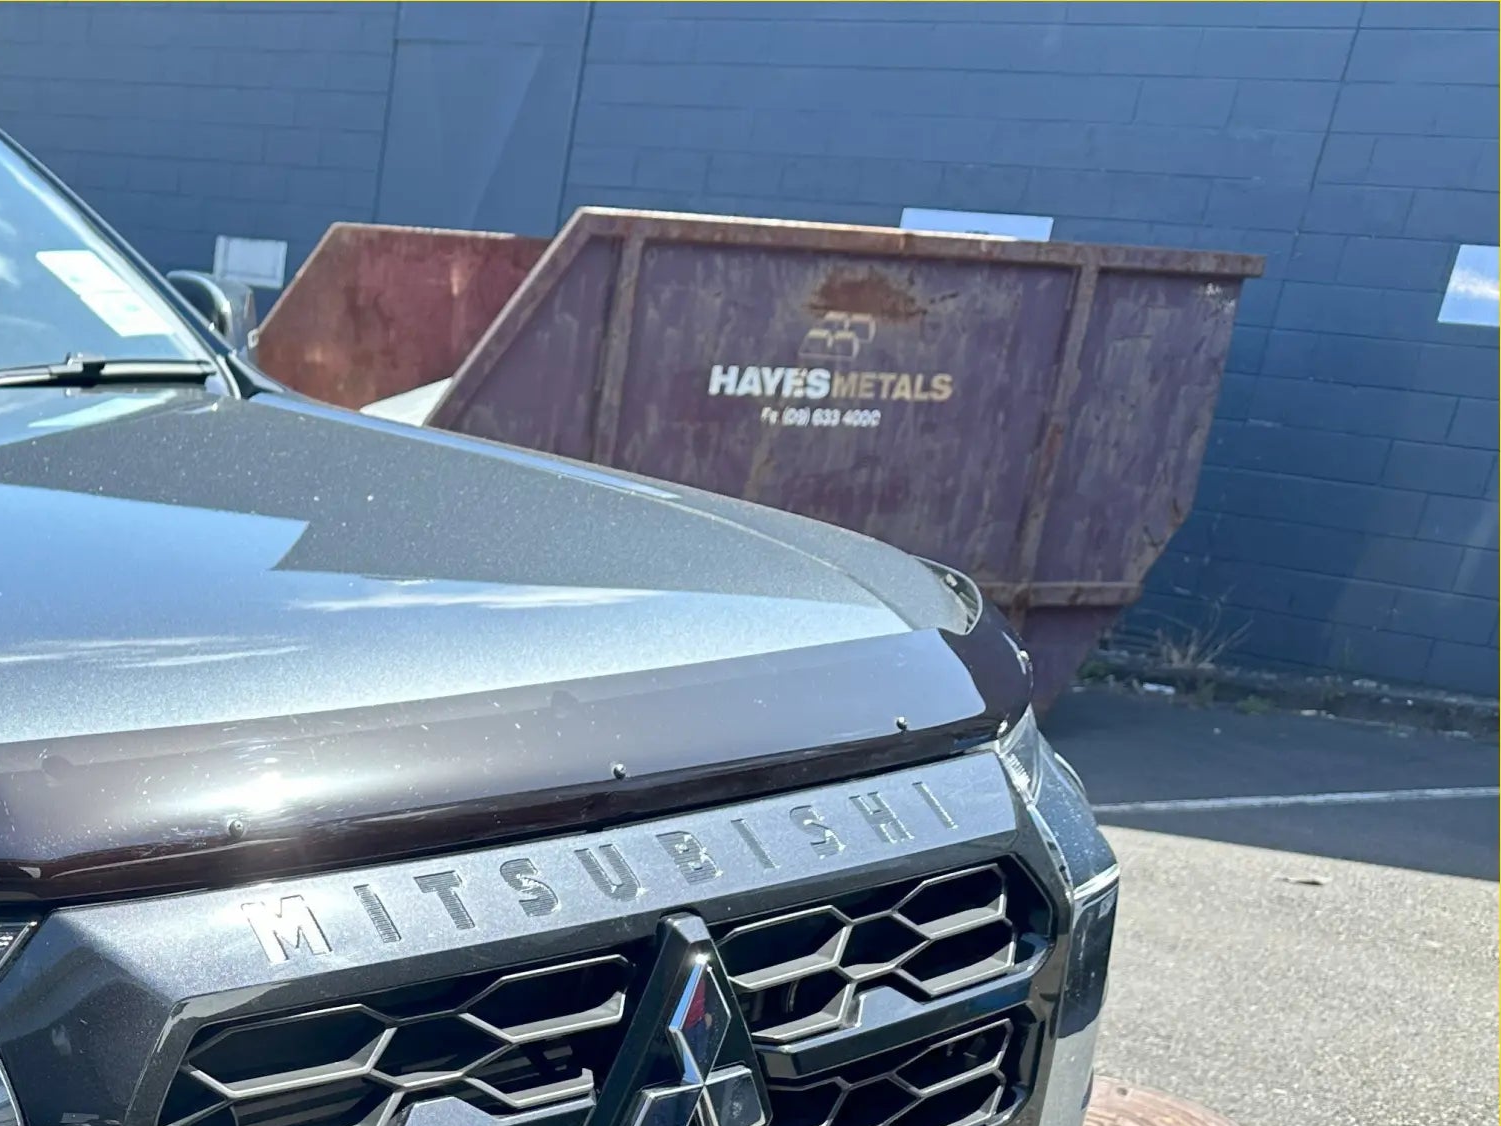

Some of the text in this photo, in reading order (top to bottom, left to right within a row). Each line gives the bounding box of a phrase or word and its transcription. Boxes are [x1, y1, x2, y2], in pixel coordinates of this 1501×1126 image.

[708, 365, 953, 402] HAYES METALS
[240, 781, 958, 965] MITSUBISHI
